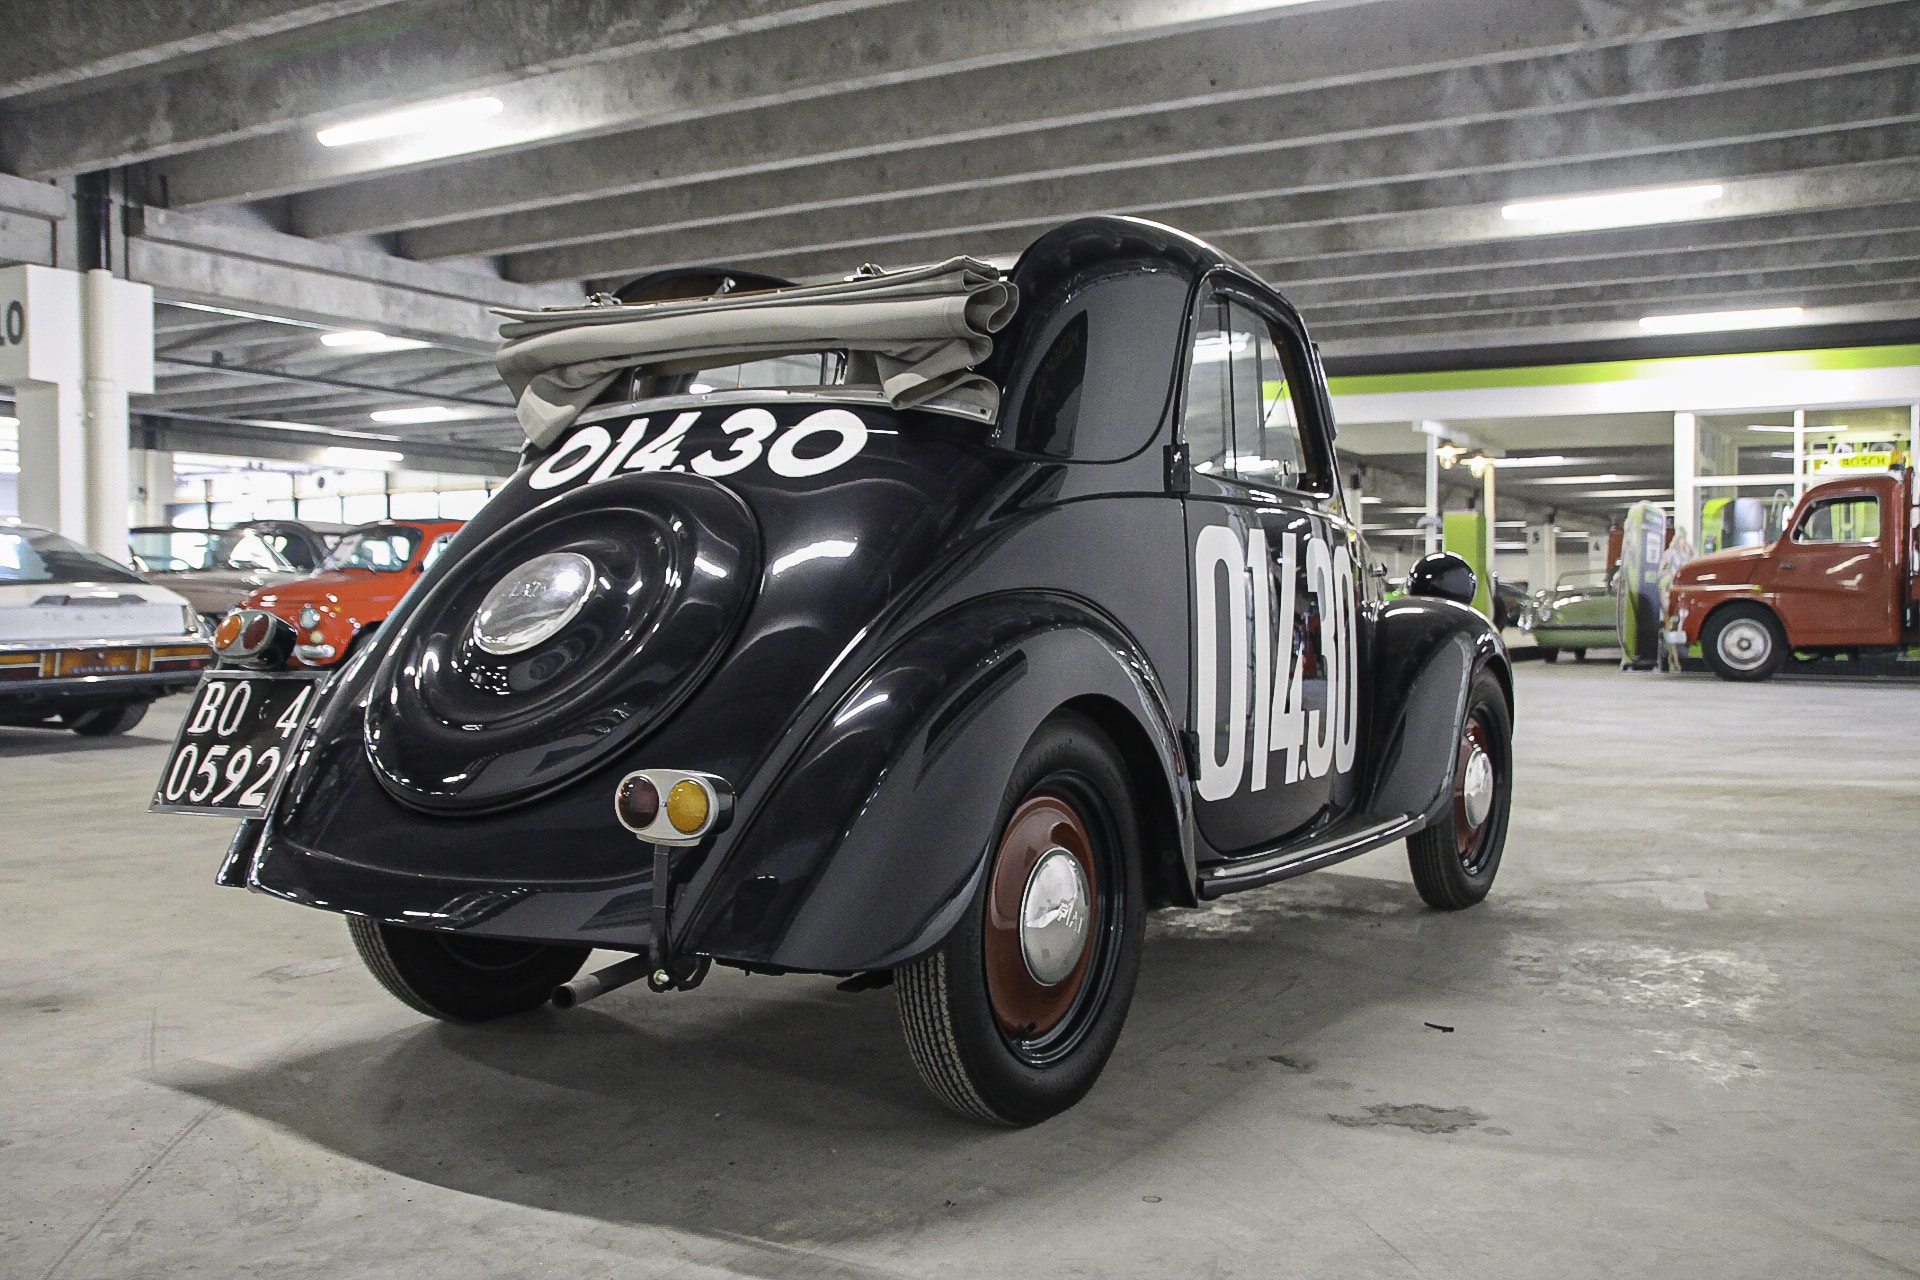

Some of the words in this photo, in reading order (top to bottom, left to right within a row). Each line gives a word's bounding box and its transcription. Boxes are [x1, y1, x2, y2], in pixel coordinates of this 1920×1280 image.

[0, 300, 24, 346] 0
[528, 407, 869, 490] 014.30
[1195, 525, 1358, 802] 014.30
[187, 680, 252, 737] BO
[275, 685, 312, 740] 4
[166, 742, 282, 807] 0592
